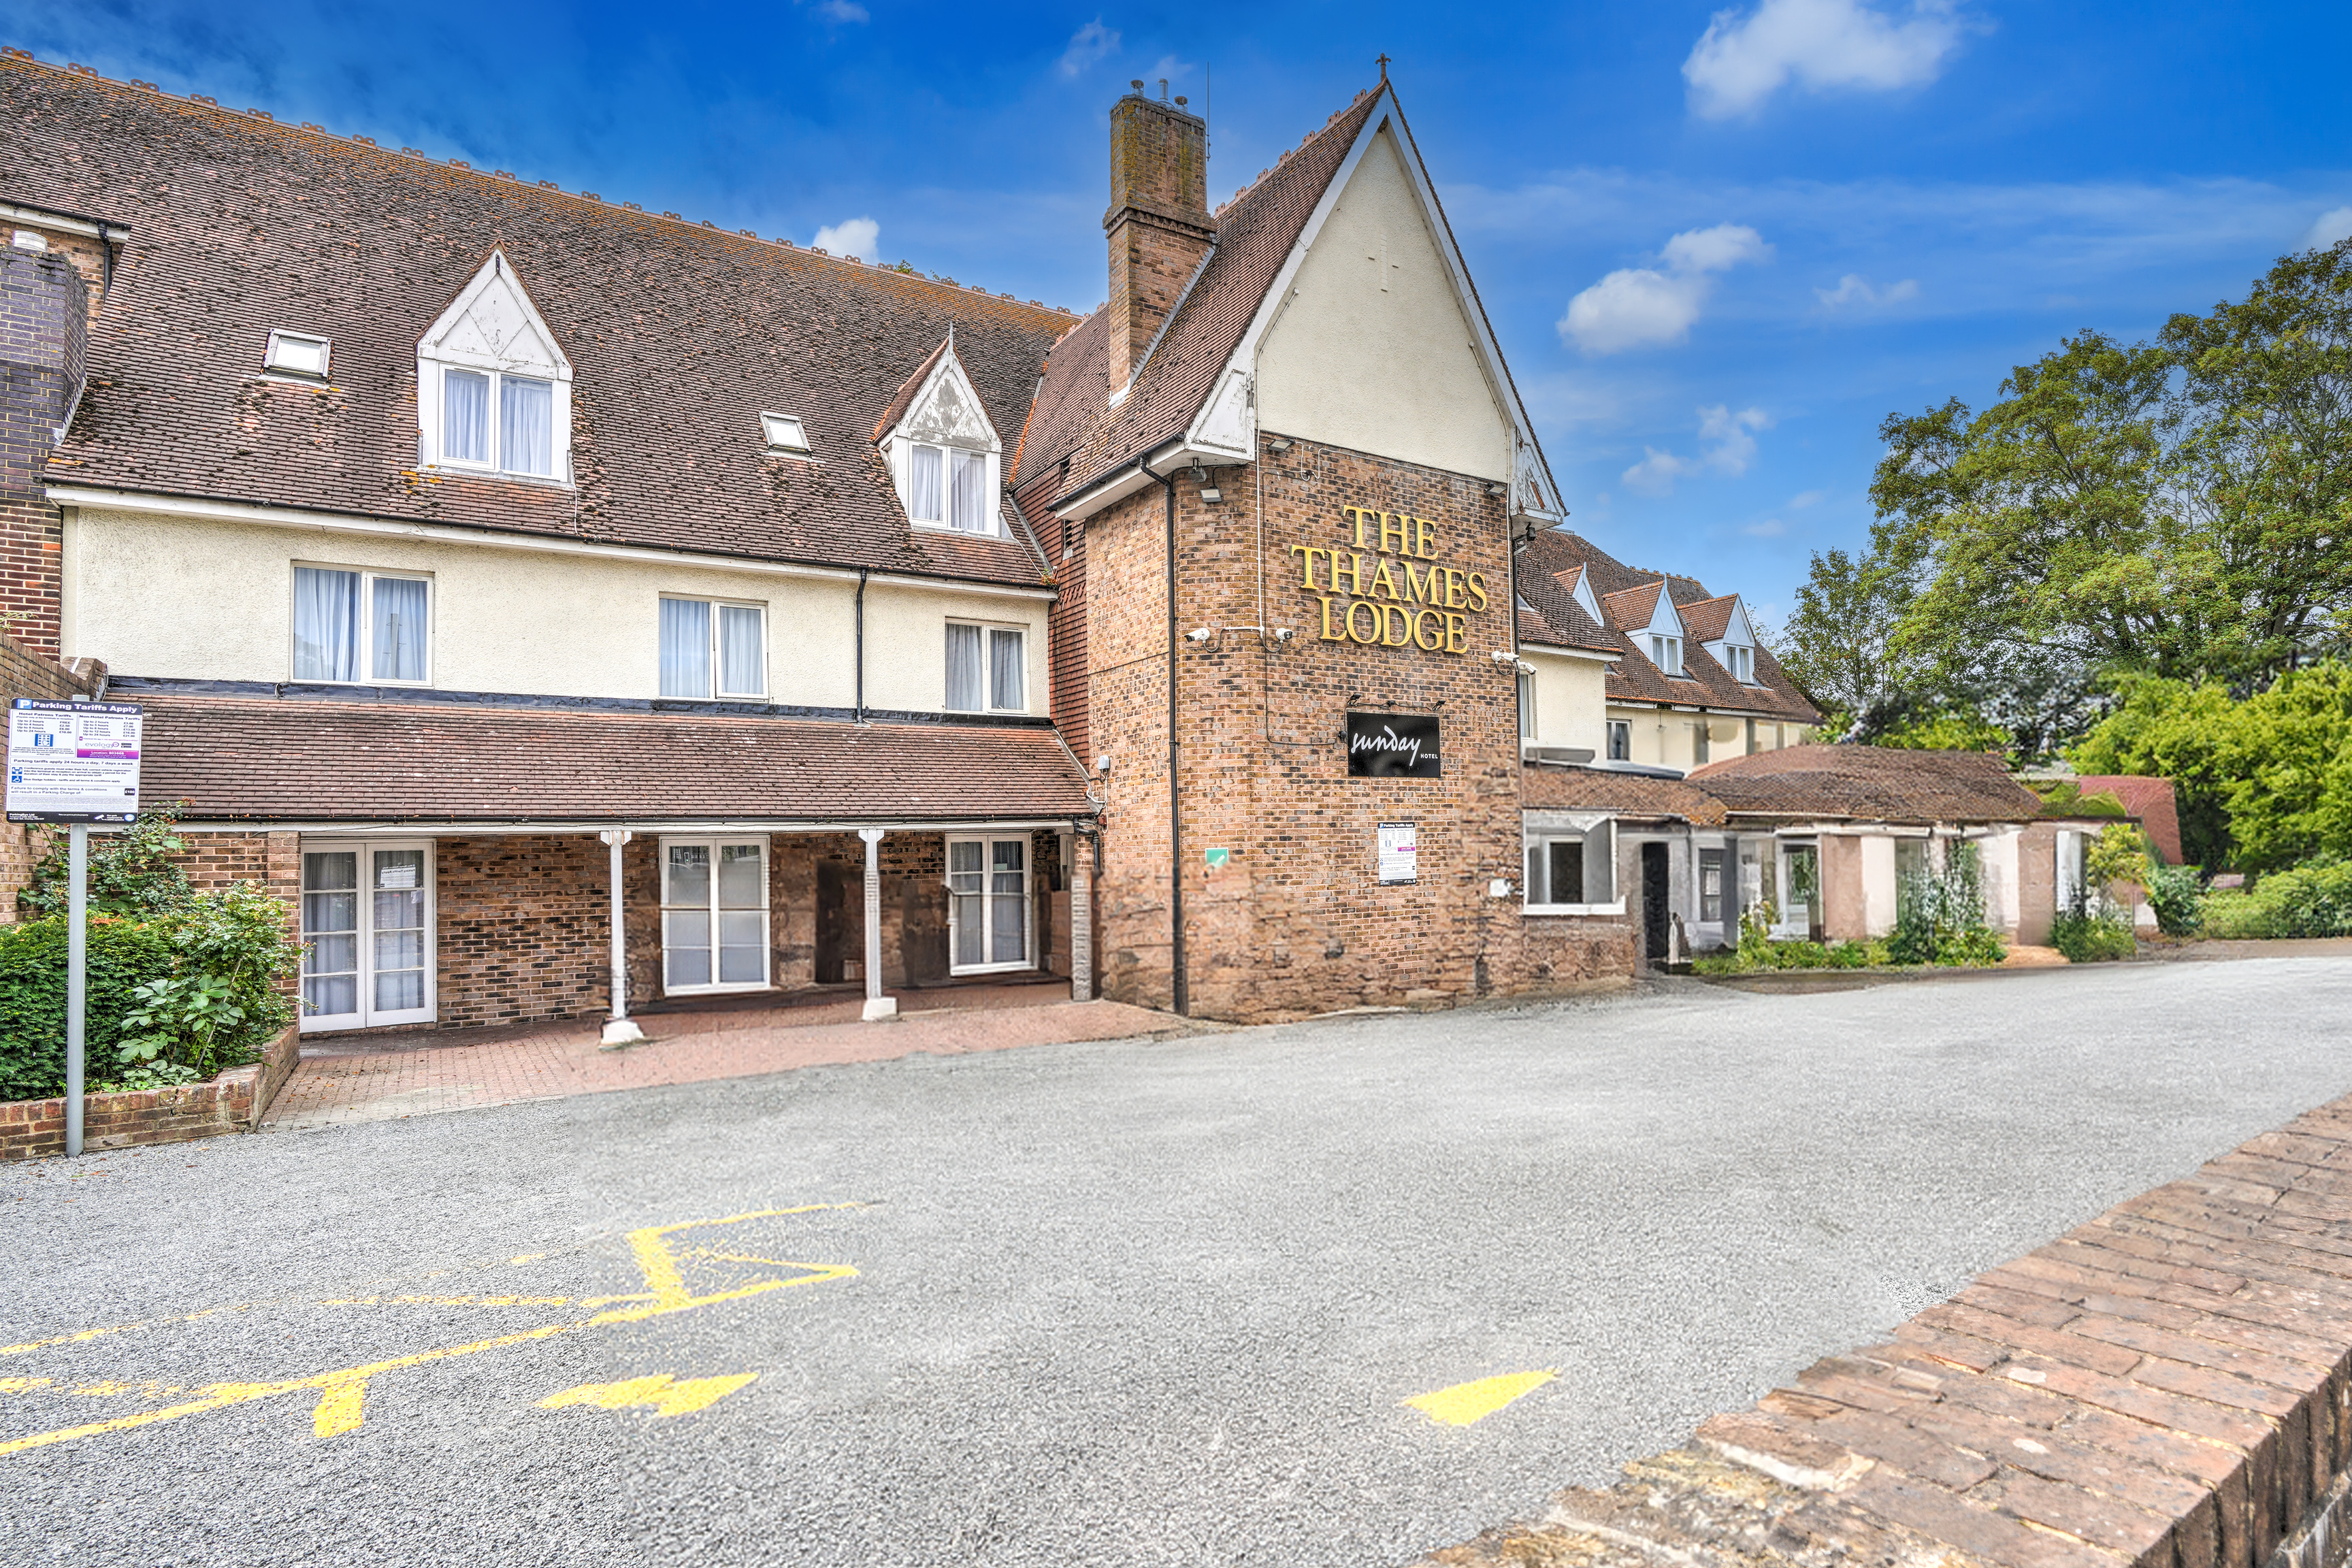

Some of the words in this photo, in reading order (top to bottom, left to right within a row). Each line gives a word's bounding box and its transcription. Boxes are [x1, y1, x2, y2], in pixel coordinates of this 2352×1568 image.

[1341, 505, 1438, 560] THE
[1289, 544, 1487, 612] THAMES
[1317, 597, 1468, 654] LODGE
[33, 702, 72, 710] Parking
[1351, 725, 1421, 766] sunday
